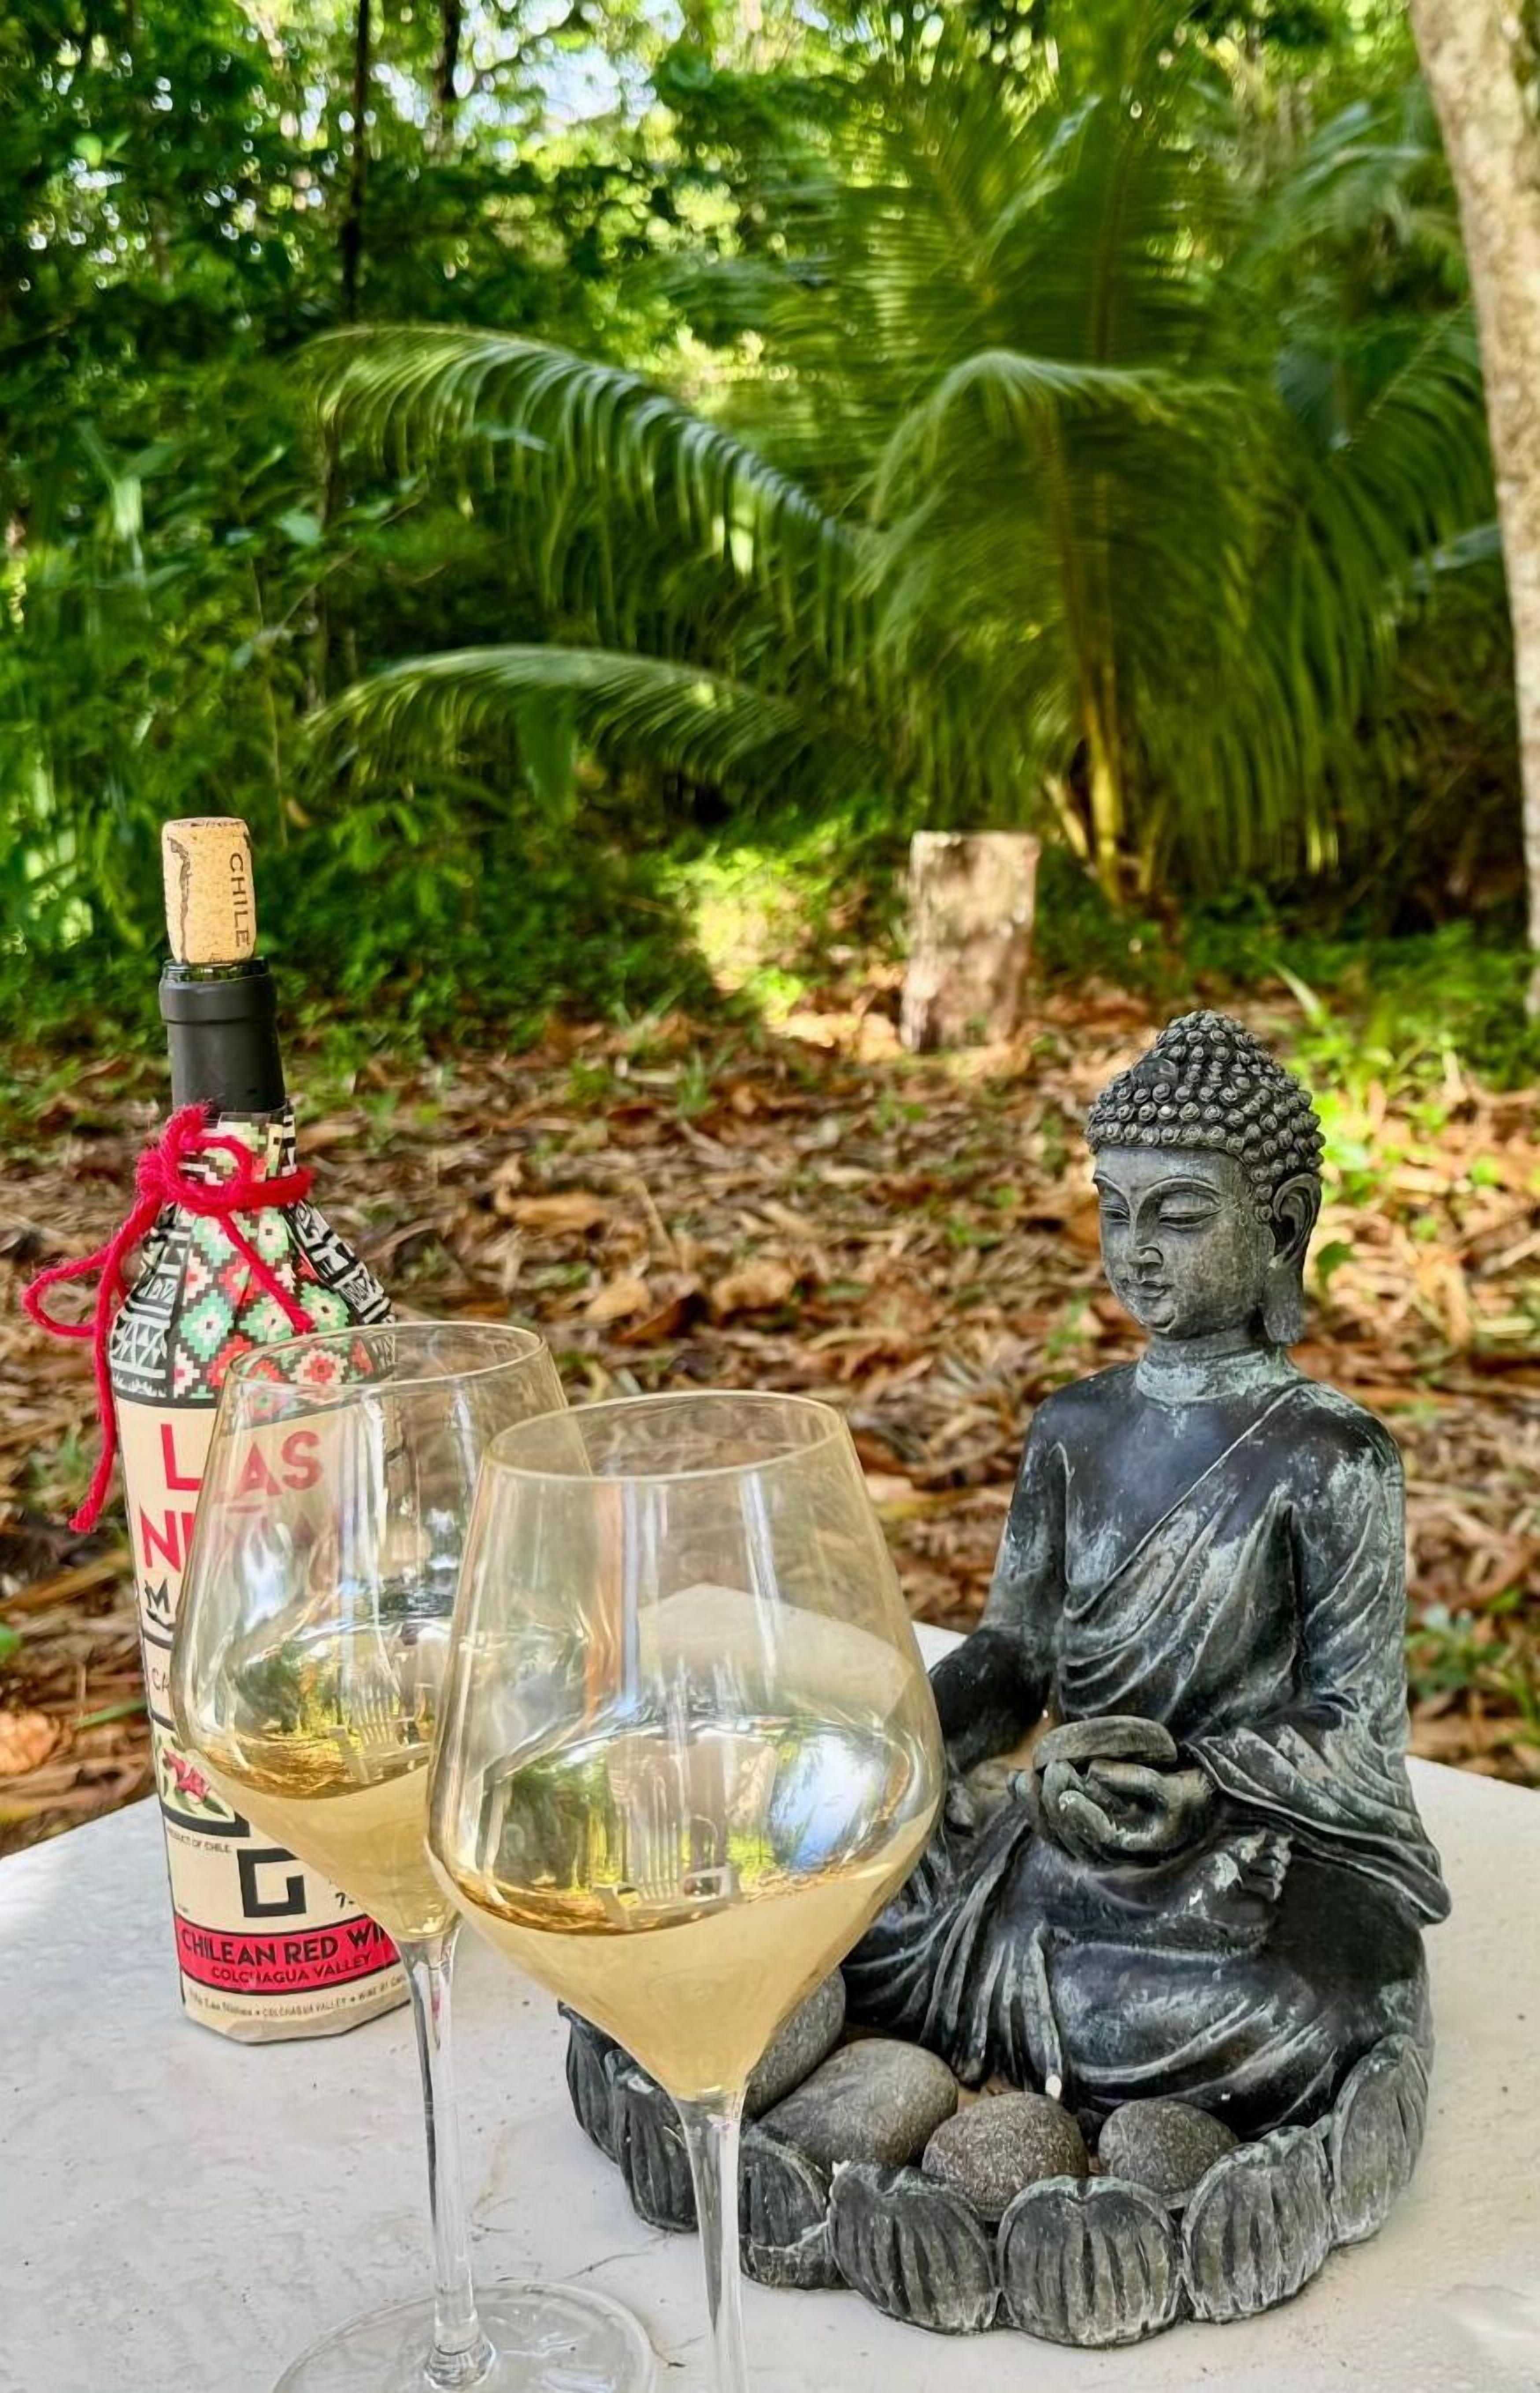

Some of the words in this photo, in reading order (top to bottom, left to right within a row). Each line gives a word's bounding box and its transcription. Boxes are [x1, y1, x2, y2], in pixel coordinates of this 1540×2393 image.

[229, 852, 250, 947] CHILE
[182, 1929, 276, 1966] CHILEAN
[283, 1936, 339, 1965] RED
[211, 1966, 310, 1983] COLCHAGUA
[313, 1952, 370, 1979] VALLEY
